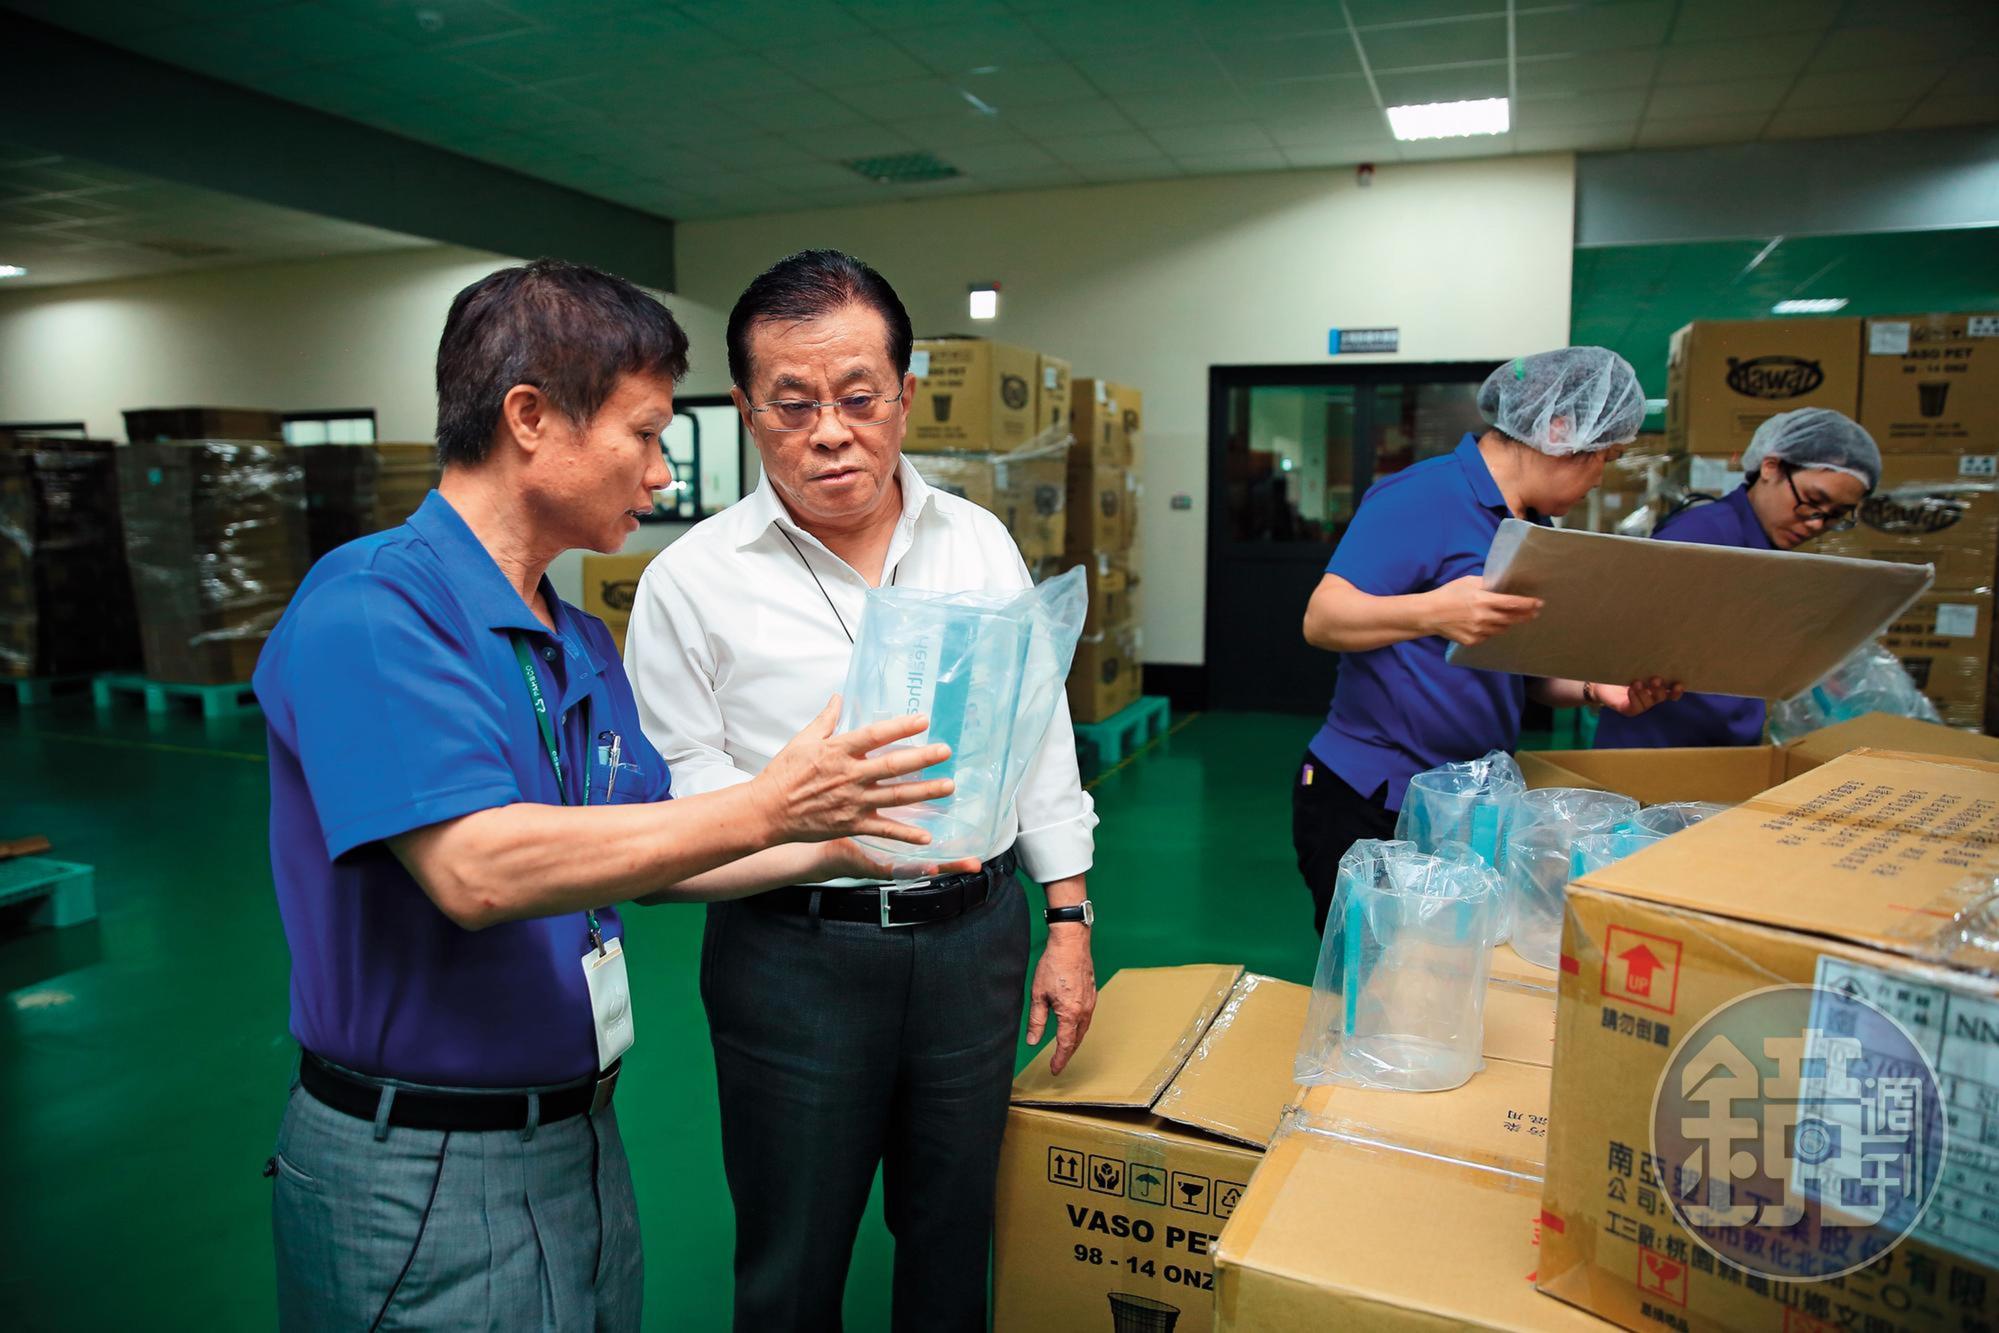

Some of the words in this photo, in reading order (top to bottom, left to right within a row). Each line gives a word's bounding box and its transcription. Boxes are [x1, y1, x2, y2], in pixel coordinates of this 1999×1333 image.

[1629, 973, 1650, 993] UP
[1066, 1204, 1155, 1243] VASO
[1074, 1244, 1103, 1266] 98
[1126, 1256, 1156, 1278] 14
[1163, 1264, 1215, 1291] ONZ
